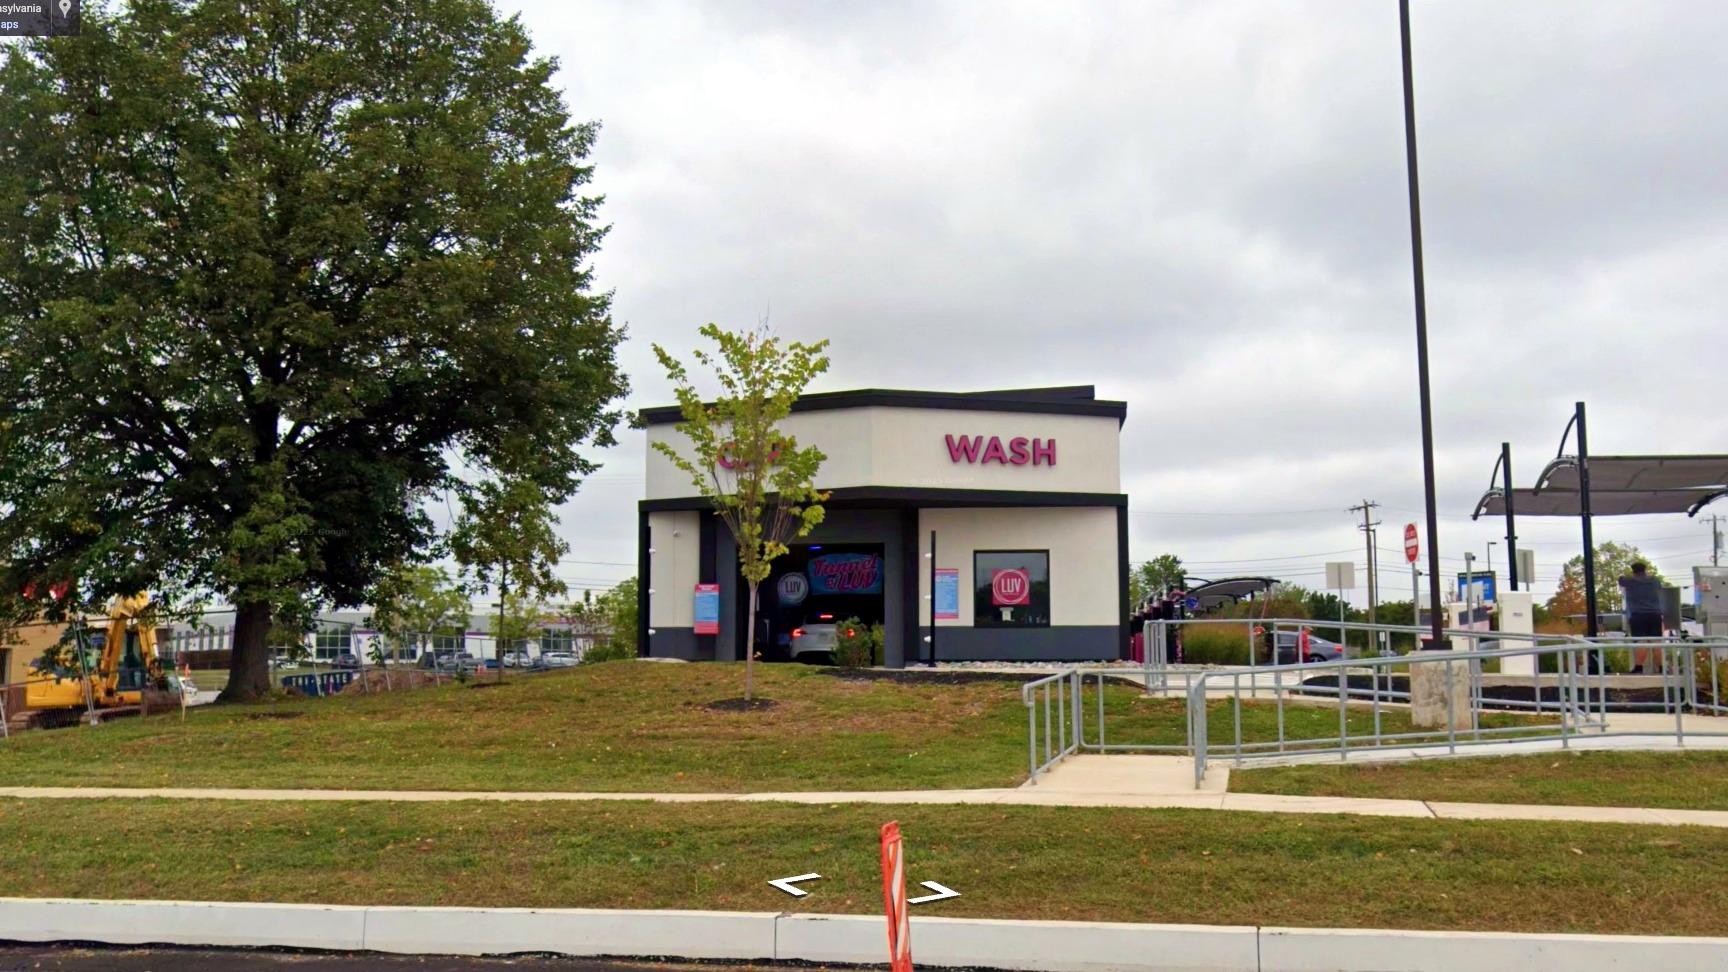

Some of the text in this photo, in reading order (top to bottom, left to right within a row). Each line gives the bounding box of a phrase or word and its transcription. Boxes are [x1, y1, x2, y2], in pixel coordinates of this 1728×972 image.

[945, 434, 1056, 466] WASH
[814, 554, 878, 576] Tunnel
[785, 581, 801, 593] LUV
[837, 569, 877, 592] LUV
[1001, 578, 1021, 593] LUV
